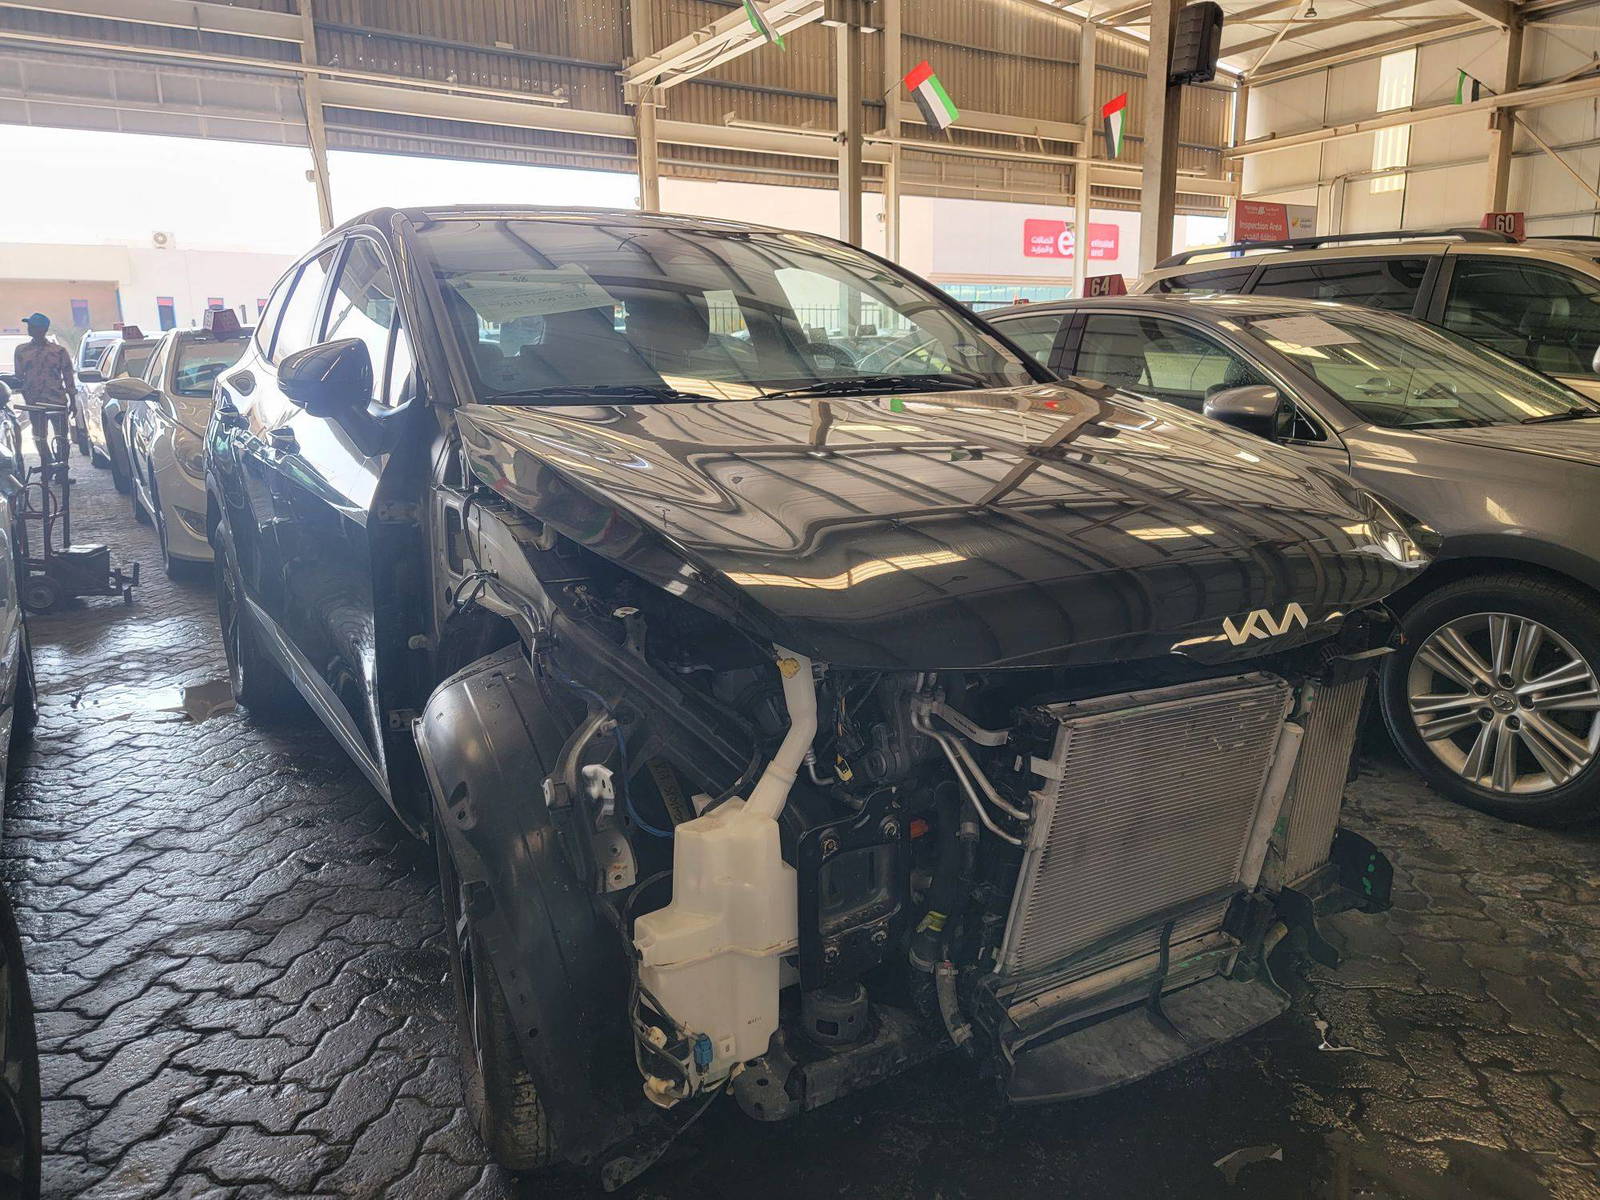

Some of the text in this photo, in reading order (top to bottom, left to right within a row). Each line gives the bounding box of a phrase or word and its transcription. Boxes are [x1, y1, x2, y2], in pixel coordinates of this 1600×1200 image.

[1240, 221, 1283, 232] Inspection Area
[1495, 214, 1514, 233] 60
[1091, 276, 1111, 297] 64
[1222, 602, 1309, 646] KIA
